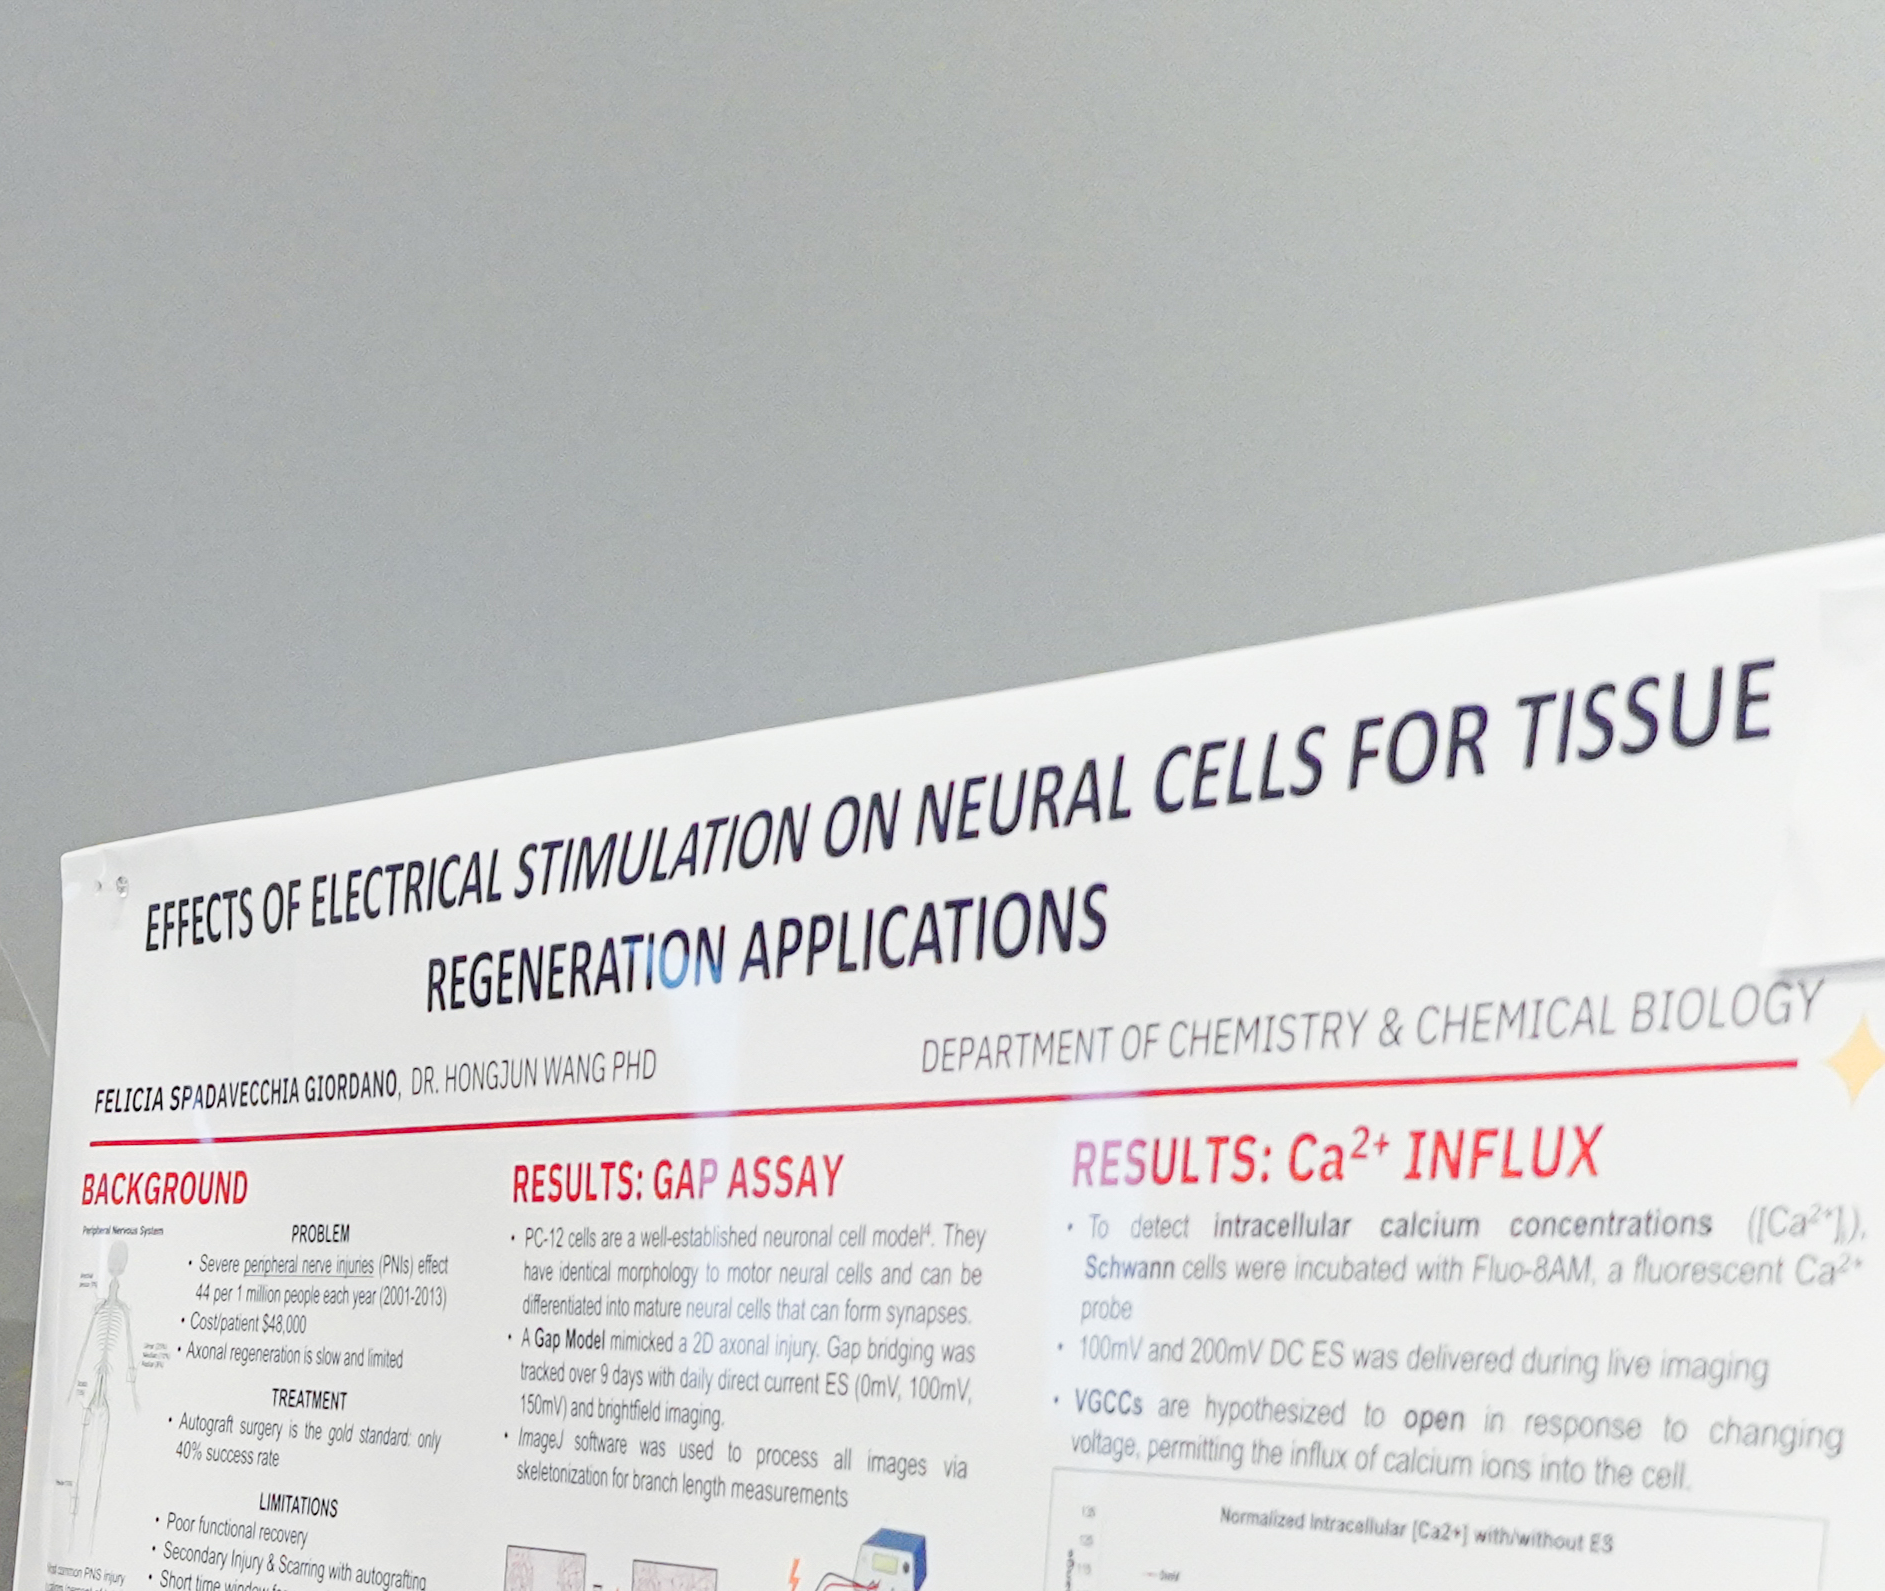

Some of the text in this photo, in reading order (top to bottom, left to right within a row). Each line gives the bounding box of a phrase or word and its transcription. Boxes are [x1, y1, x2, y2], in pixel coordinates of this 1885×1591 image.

[145, 658, 1776, 952] EFFECTS OF ELECTRICAL STIMULATION ON NEURAL CELLS FOR TISSUE
[427, 882, 1108, 1013] REGENERATION APPLICATIONS
[921, 977, 1826, 1074] DEPARTMENT OF CHEMISTRY & CHEMICAL BIOLOGY
[94, 1048, 657, 1114] FELICIA SPADAVECCHIA GIORDANO, DR. HONGJUN WANG PHD
[1073, 1134, 1272, 1186] RESULTS:
[1404, 1124, 1604, 1180] INFLUX
[81, 1170, 248, 1206] BACKGROUND
[513, 1154, 844, 1203] RESULTS: GAP ASSAY
[291, 1223, 350, 1243] PROBLEM
[525, 1225, 758, 1249] PC-12 cells well-established
[1213, 1208, 1713, 1239] intracellular calcium concentrations
[199, 1253, 449, 1278] Severe peripheral nerve injuries (PNIs) effect
[245, 1284, 447, 1311] million people each year (2001-2013)
[534, 1326, 606, 1353] Gap Model
[272, 1387, 348, 1410] TREATMENT
[259, 1492, 339, 1519] LIMITATIONS
